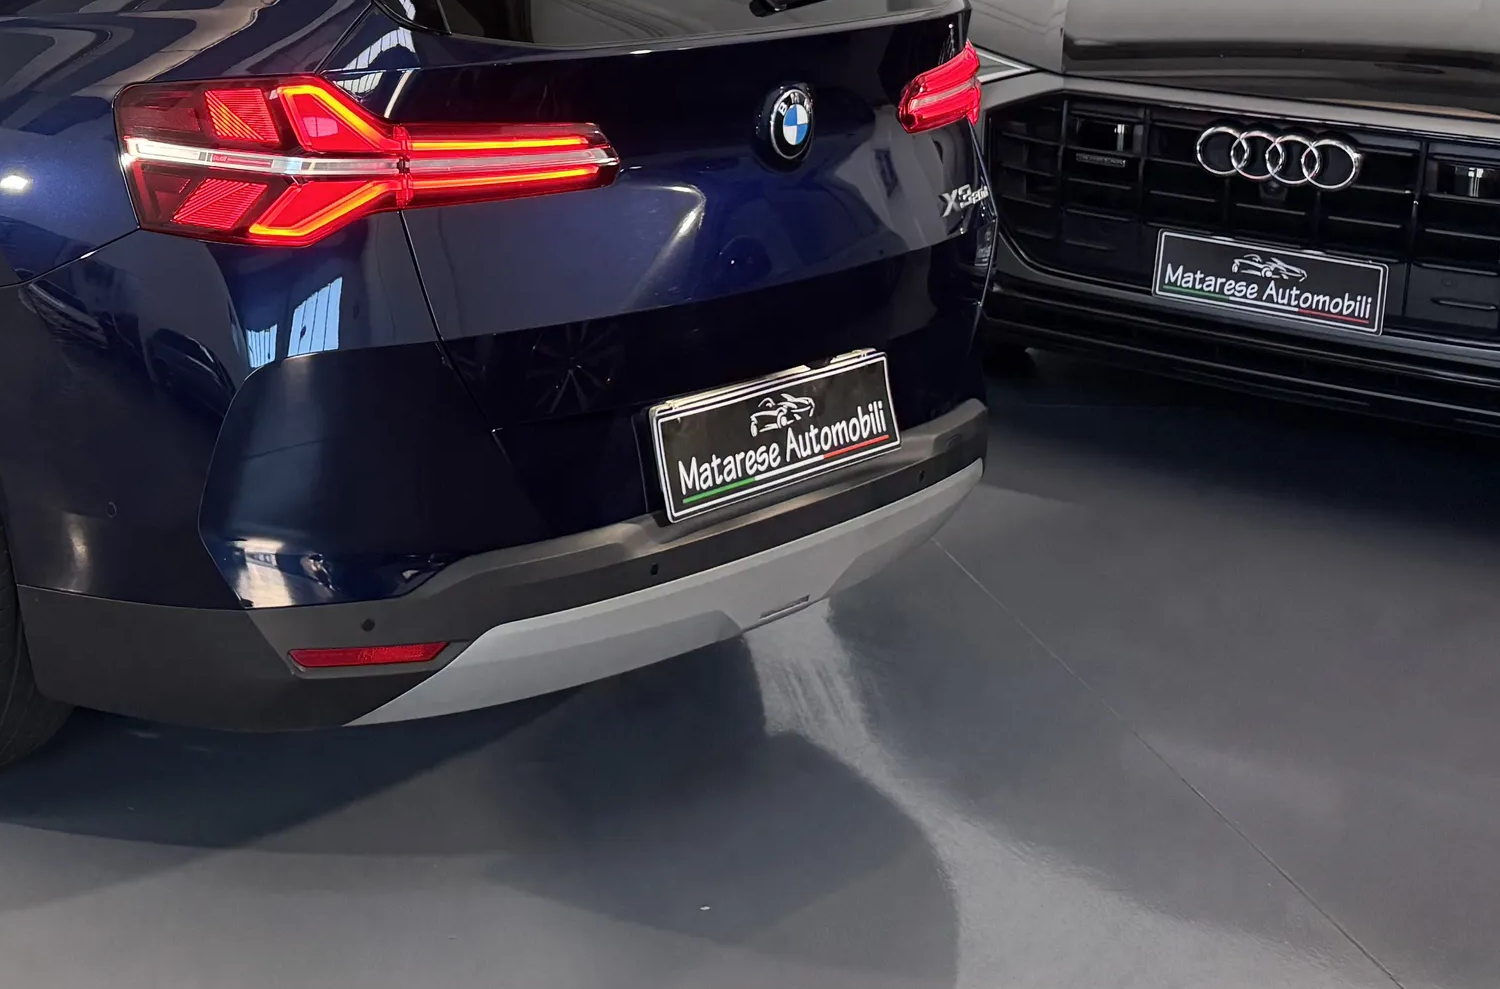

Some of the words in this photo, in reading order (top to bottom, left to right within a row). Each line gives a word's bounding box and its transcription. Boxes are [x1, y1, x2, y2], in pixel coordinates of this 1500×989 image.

[941, 183, 972, 218] X3
[1164, 263, 1258, 298] Matarese
[1262, 280, 1372, 319] Automobili
[678, 442, 781, 495] Matarese
[786, 400, 887, 462] Automobili
